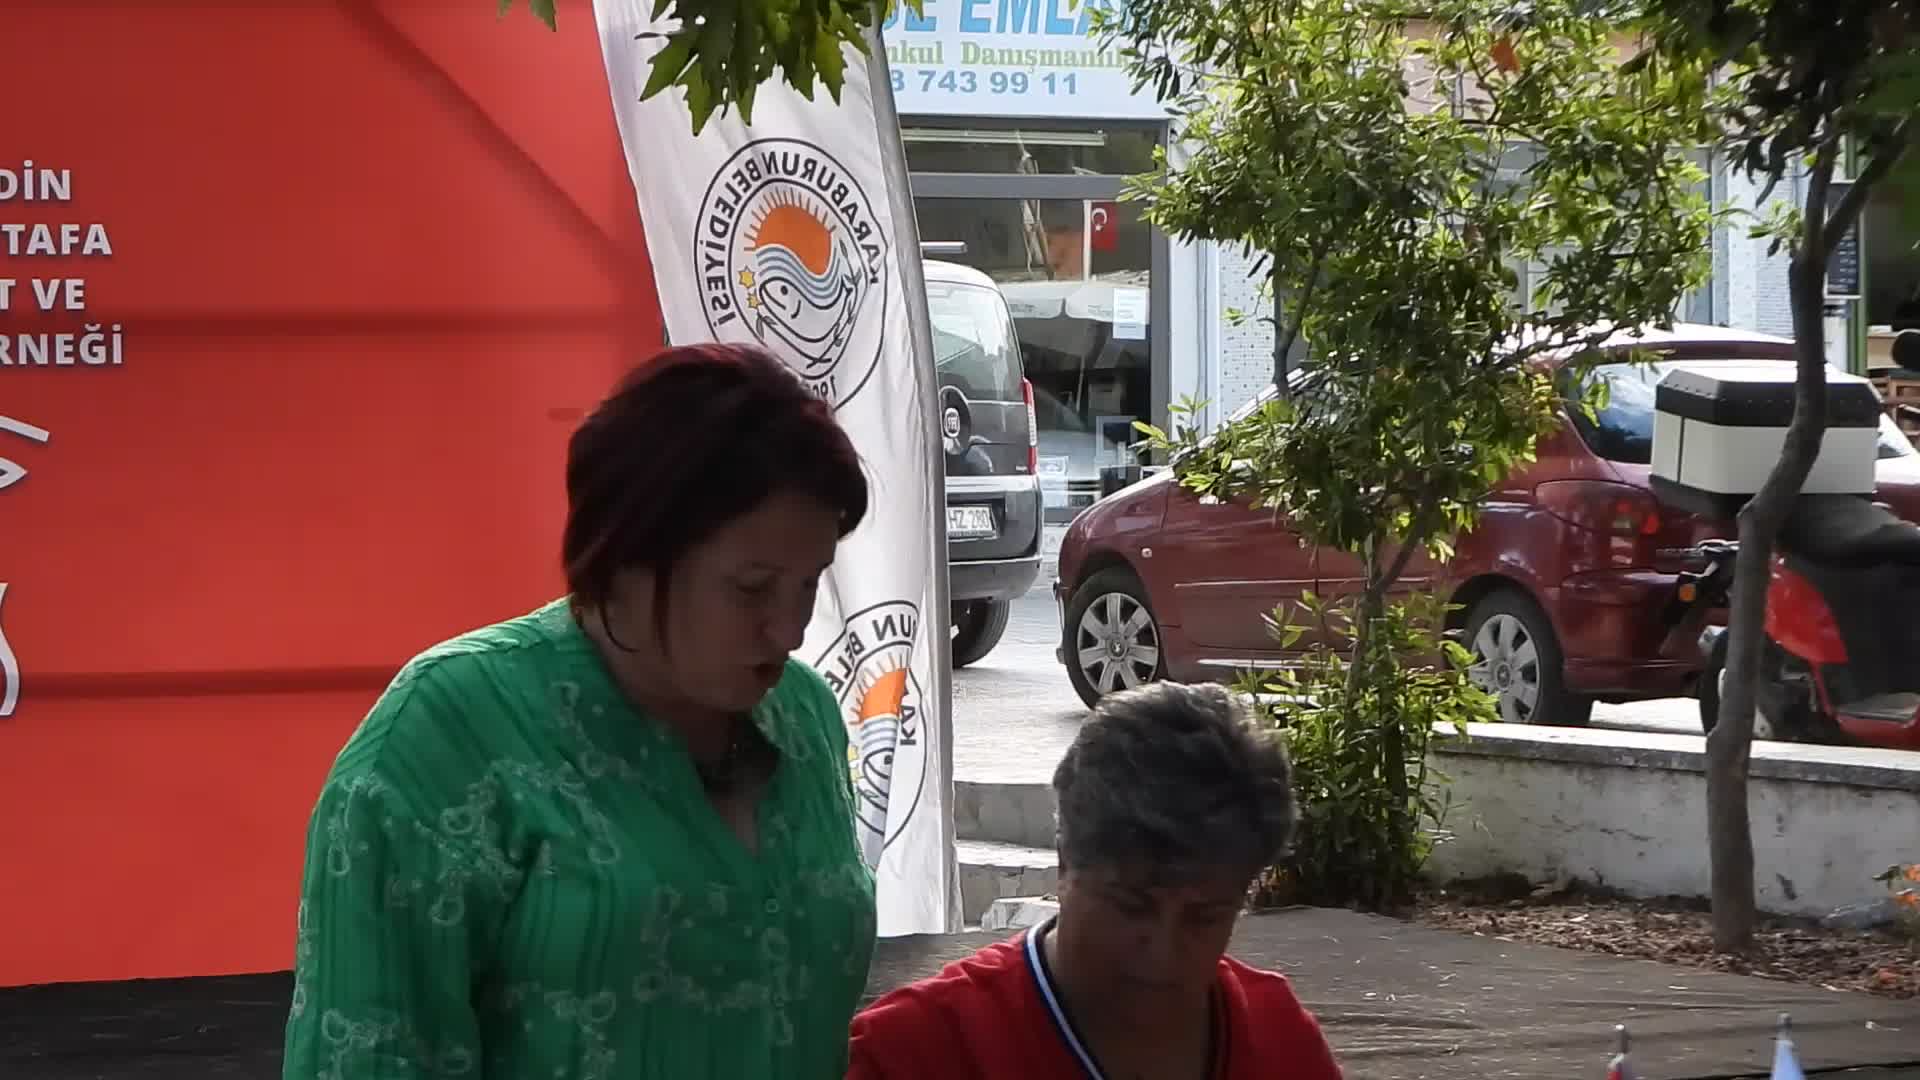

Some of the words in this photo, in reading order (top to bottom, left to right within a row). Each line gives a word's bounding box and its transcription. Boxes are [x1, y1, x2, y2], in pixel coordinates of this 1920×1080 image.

[918, 69, 978, 94] 743
[990, 71, 1029, 94] 99
[1042, 72, 1077, 95] 11
[2, 223, 112, 255] TAFA
[32, 279, 85, 310] VE
